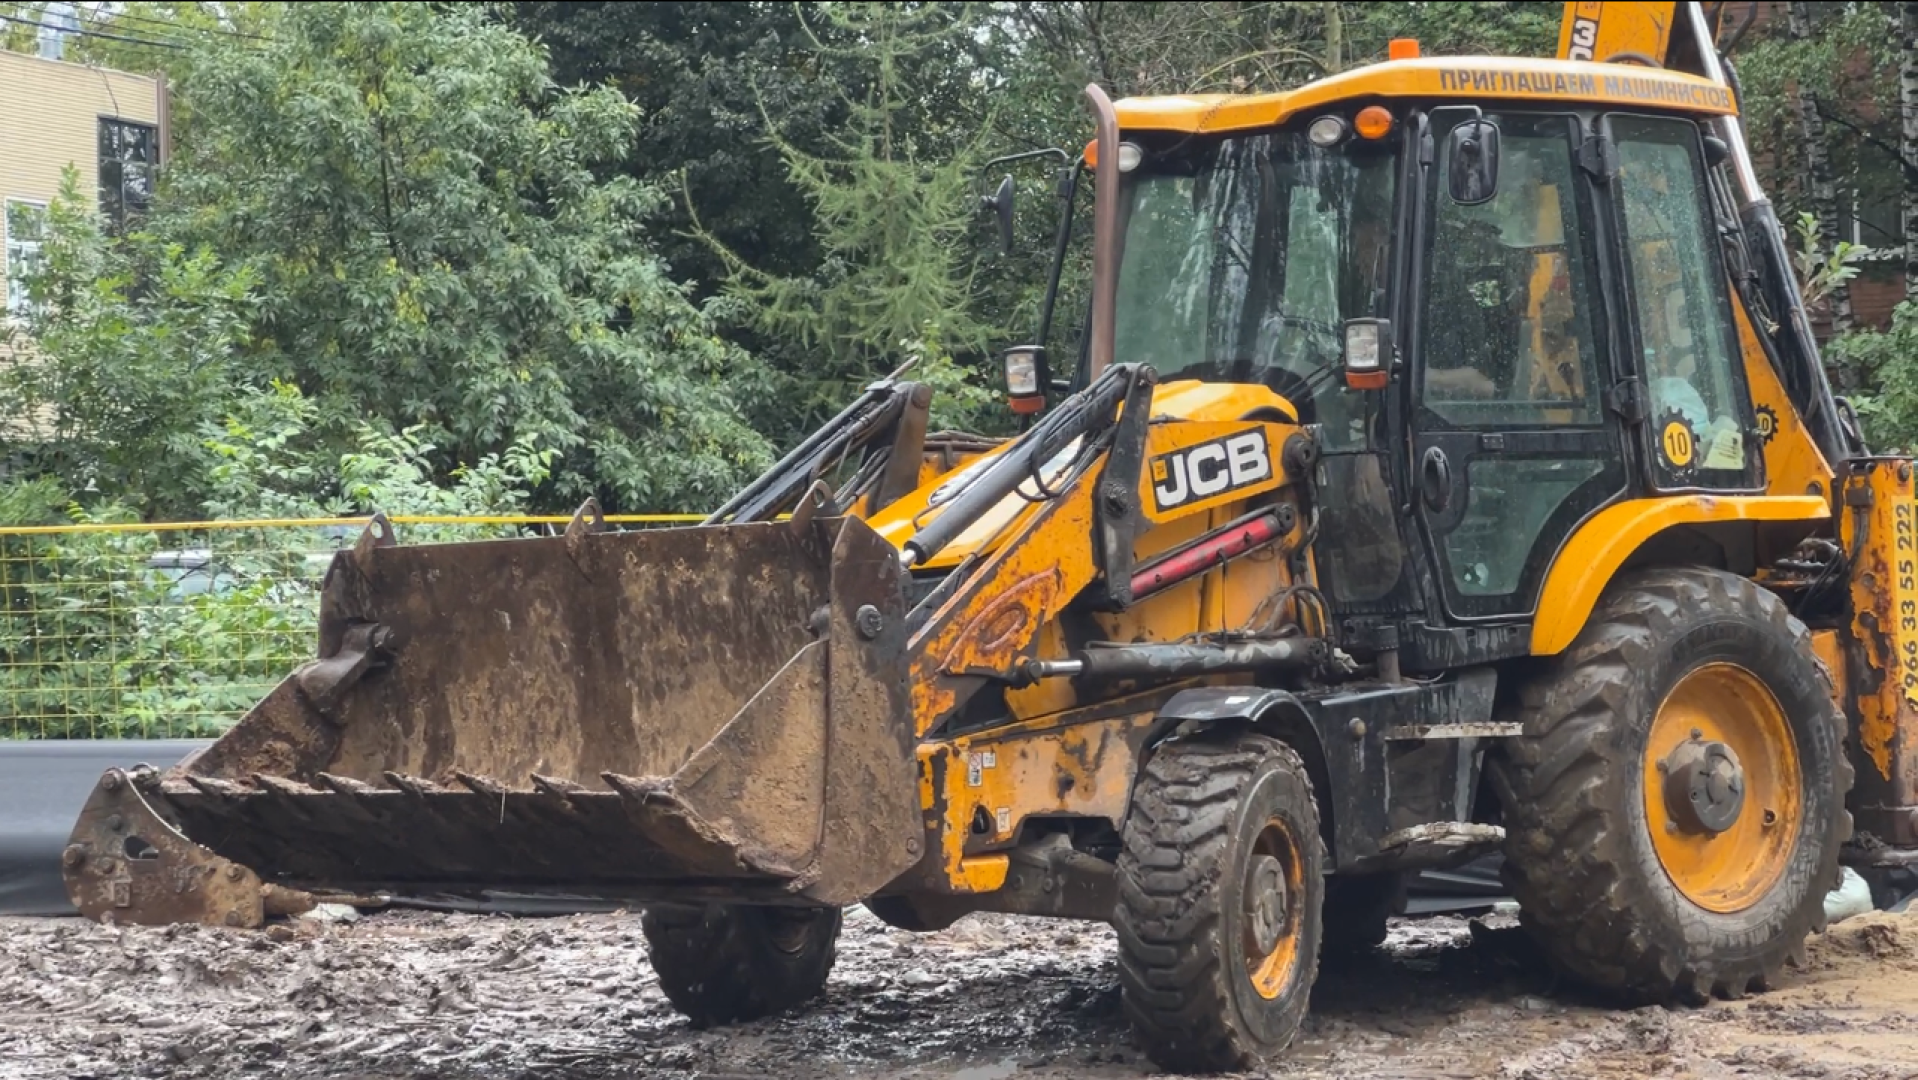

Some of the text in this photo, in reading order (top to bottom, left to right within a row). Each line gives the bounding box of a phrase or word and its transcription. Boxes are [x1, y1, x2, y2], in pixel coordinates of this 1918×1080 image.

[1440, 69, 1731, 107] ПРИГЛАШАЕМ МАШИНИСТОВ
[1668, 431, 1689, 457] 10
[1156, 432, 1269, 506] JCB
[1896, 503, 1912, 550] 222
[1898, 559, 1915, 591] 55
[1901, 600, 1917, 631] 33
[1903, 640, 1918, 688] 966
